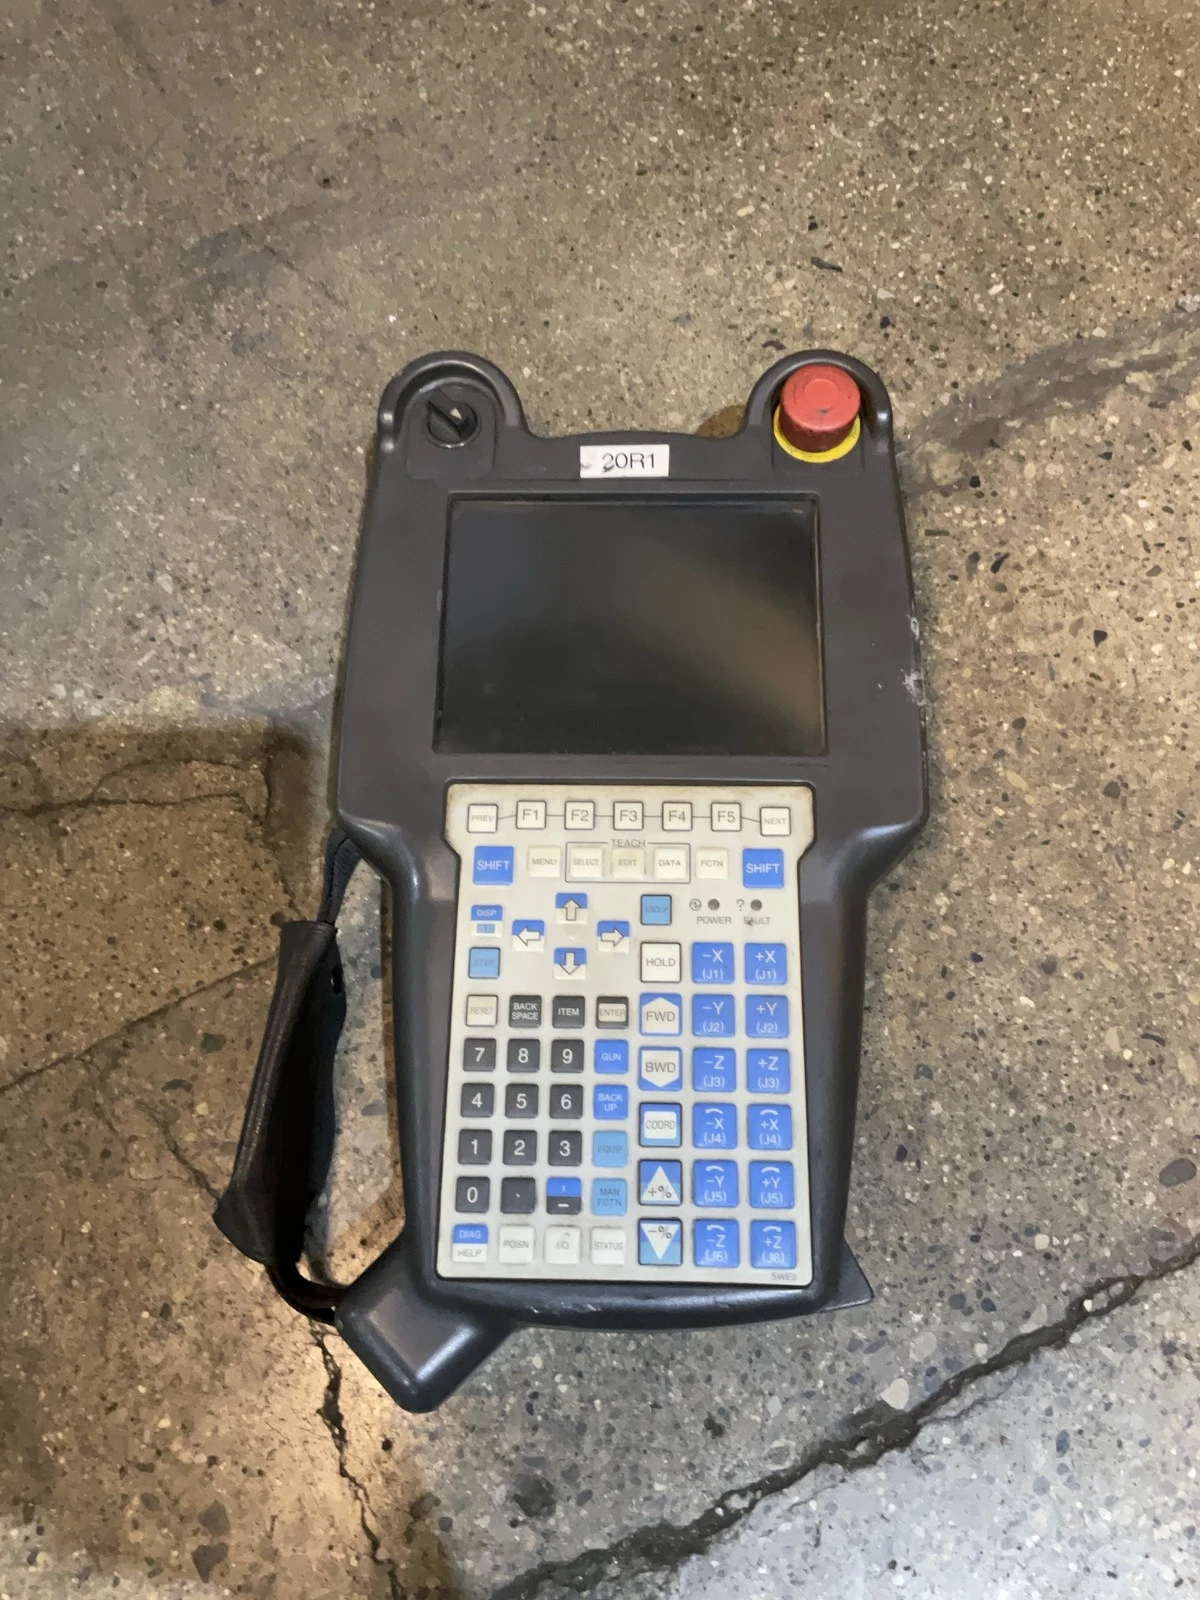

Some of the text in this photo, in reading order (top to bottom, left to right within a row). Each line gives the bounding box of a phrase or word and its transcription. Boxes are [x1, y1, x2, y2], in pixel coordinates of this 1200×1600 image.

[602, 453, 654, 470] 20R1
[471, 814, 495, 822] PREV
[522, 808, 539, 821] F1
[570, 809, 589, 822] F2
[619, 809, 638, 822] F3
[668, 810, 686, 822] F4
[717, 811, 736, 823] F5
[611, 838, 646, 848] TEACH
[476, 860, 510, 871] SHIFT
[531, 858, 557, 866] MENU
[572, 858, 600, 866] SELECT
[618, 859, 637, 867] EDIT
[658, 859, 681, 867] DATA
[700, 860, 724, 868] FCTN
[746, 863, 780, 874] SHIFT
[476, 909, 497, 917] DISP
[696, 916, 732, 925] POWER
[743, 916, 771, 925] FAULT
[646, 958, 676, 967] HOLD
[513, 1002, 537, 1011] BACK
[512, 1012, 538, 1020] SPACE
[558, 1008, 580, 1016] ITEM
[600, 1009, 626, 1017] ENTER
[646, 1011, 676, 1022] FWD
[474, 1047, 486, 1063] 7
[517, 1048, 529, 1064] 8
[562, 1048, 573, 1064] 9
[645, 1062, 676, 1072] BWD
[471, 1092, 483, 1108] 4
[516, 1093, 527, 1109] 5
[560, 1093, 572, 1110] 6
[598, 1093, 623, 1102] BACK
[604, 1103, 617, 1112] UP
[645, 1120, 676, 1130] COORD
[470, 1138, 478, 1155] 1
[514, 1140, 526, 1156] 2
[559, 1140, 571, 1157] 3
[466, 1186, 478, 1203] 0
[594, 1241, 624, 1250] STATUS
[457, 1248, 482, 1257] HELP
